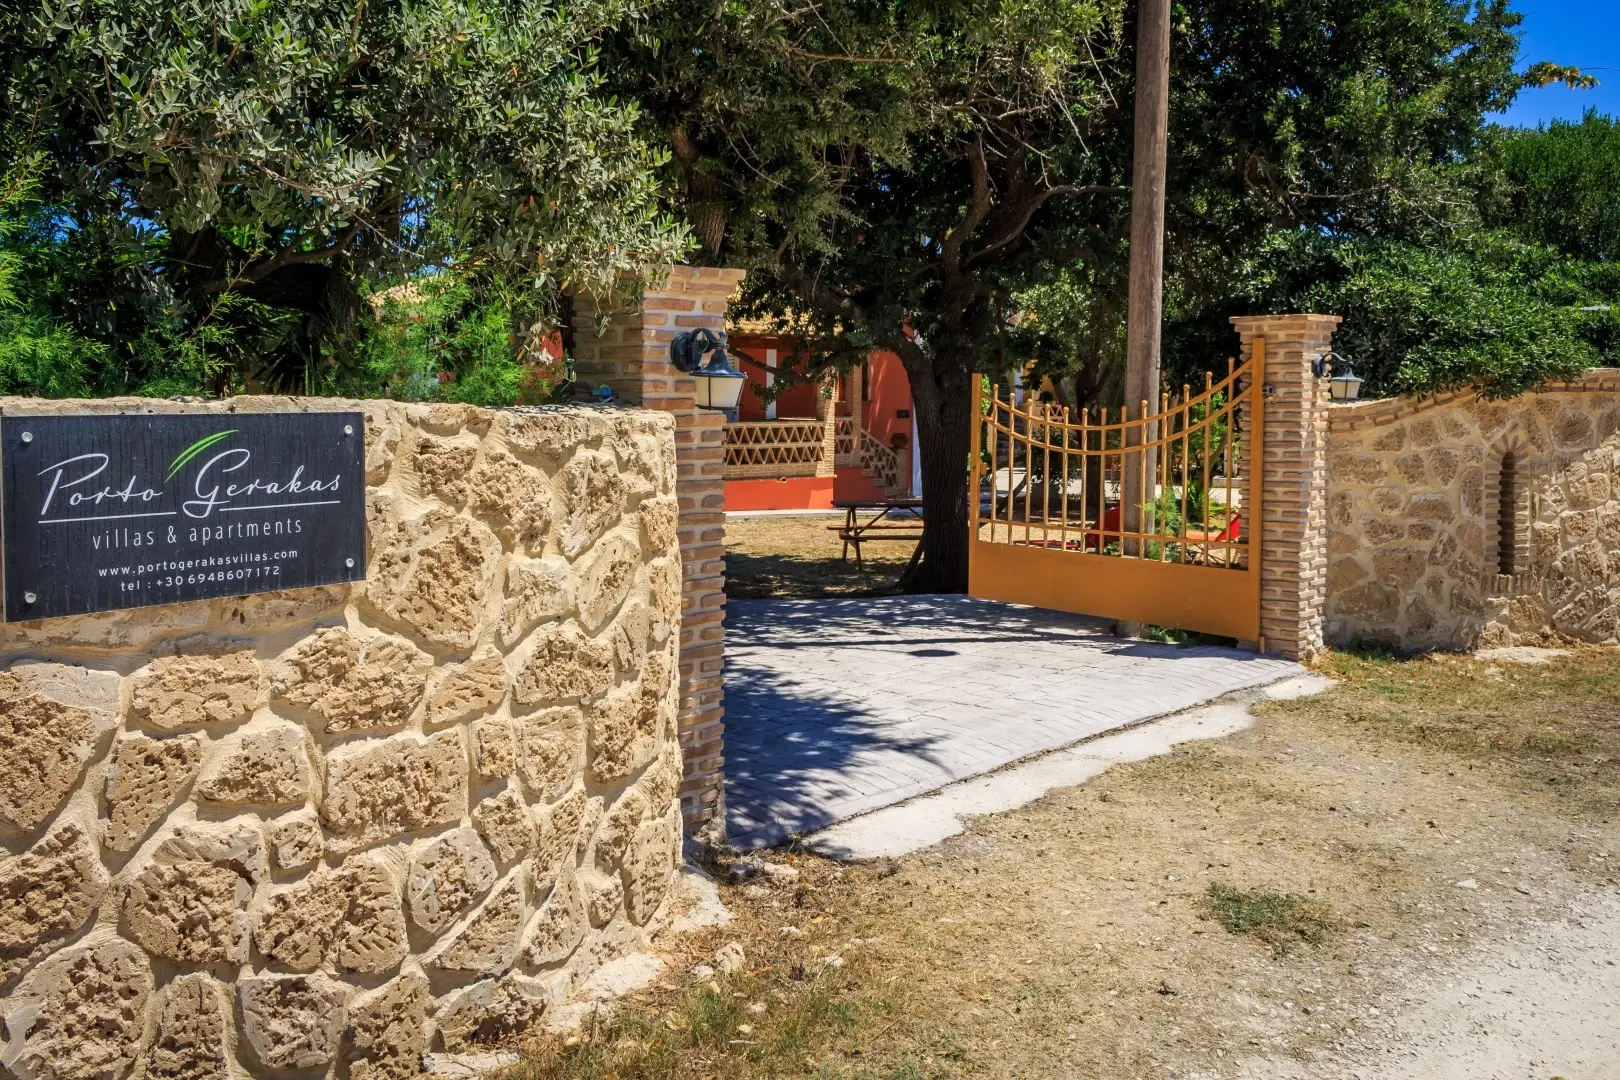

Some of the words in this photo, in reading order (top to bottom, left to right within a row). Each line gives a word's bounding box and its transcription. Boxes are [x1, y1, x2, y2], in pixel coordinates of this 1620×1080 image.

[37, 453, 163, 515] Porto
[182, 448, 341, 518] Gerakas
[92, 528, 154, 550] villas
[167, 526, 177, 543] &
[189, 517, 302, 545] apartments
[98, 550, 298, 576] www.portogerakasvillas.com
[120, 581, 141, 591] tel
